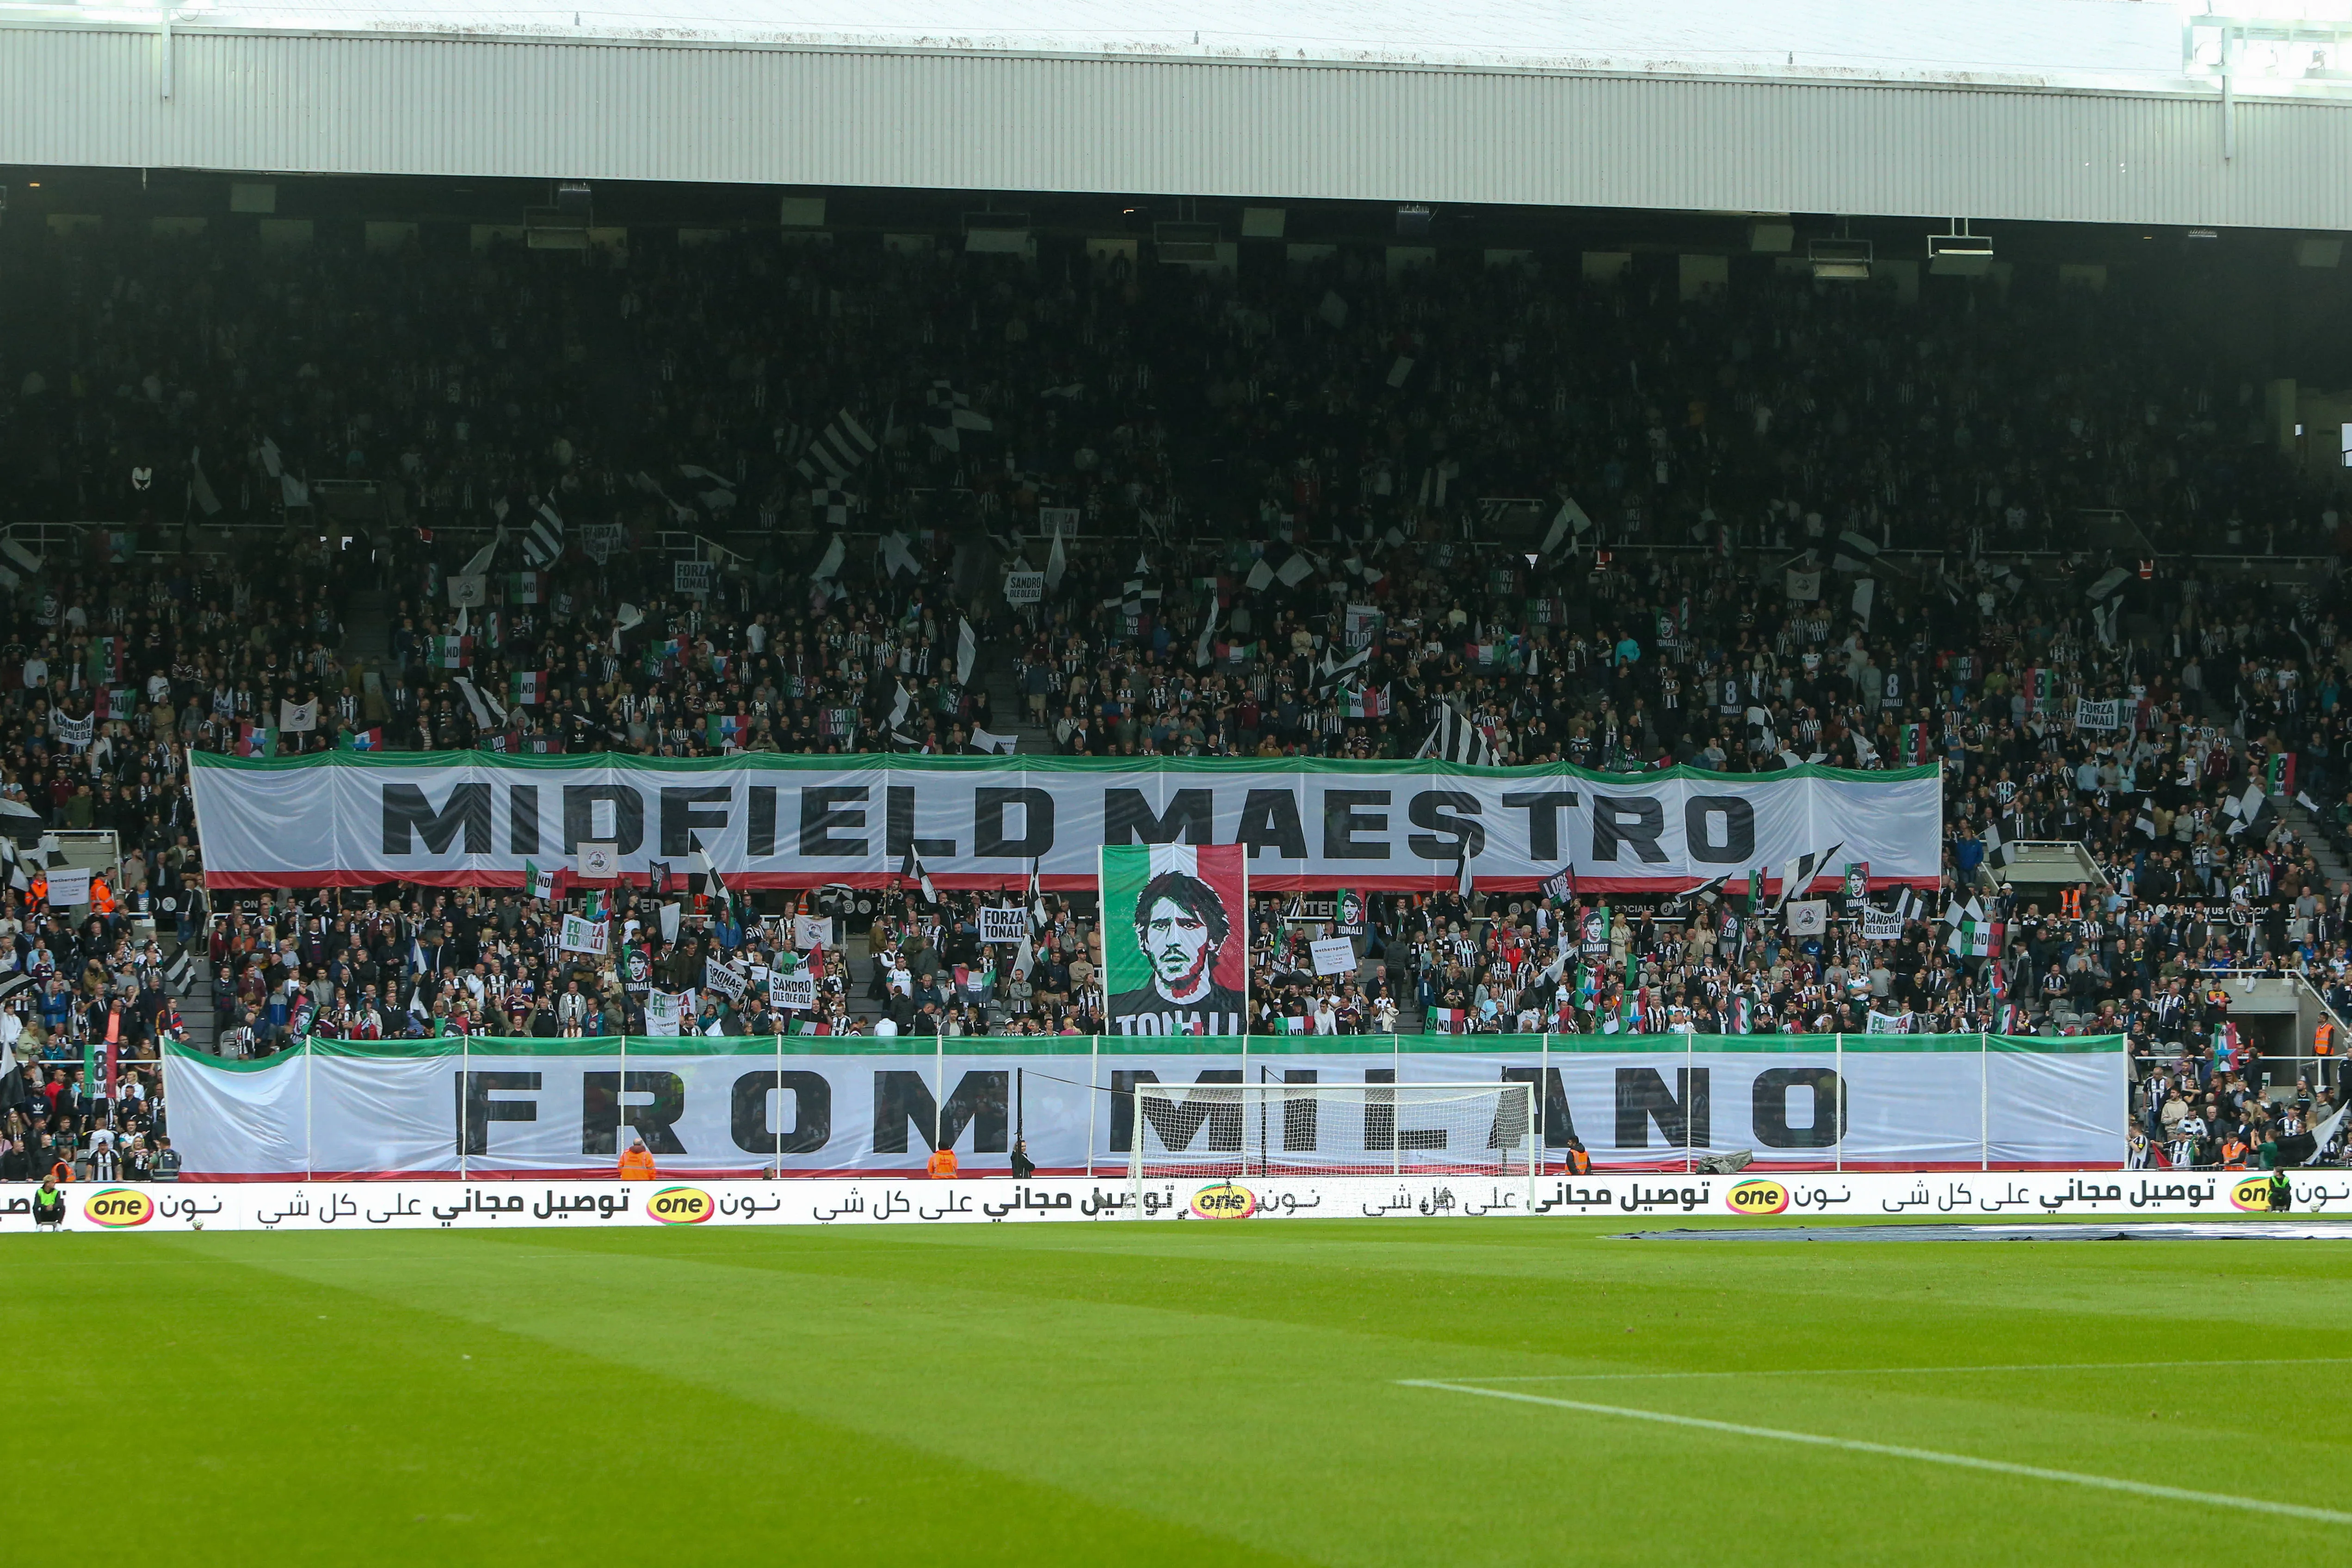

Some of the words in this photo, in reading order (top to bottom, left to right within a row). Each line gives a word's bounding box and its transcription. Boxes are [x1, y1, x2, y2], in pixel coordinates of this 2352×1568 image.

[677, 578, 709, 589] TONAL
[1010, 577, 1041, 589] SANDRO
[1020, 590, 1031, 598] OLE
[1031, 589, 1041, 598] OLE
[1725, 680, 1737, 704] 8
[1887, 673, 1898, 698] 8
[1882, 698, 1902, 707] TONALI
[2080, 704, 2114, 715] FORZA
[1721, 706, 1741, 715] TONALI
[2079, 714, 2114, 726] TONALI
[2275, 758, 2288, 782] 8
[382, 783, 1054, 857] MIDFIELD
[1105, 788, 1757, 863] MAESTRO
[1845, 898, 1870, 906] TONALI
[984, 910, 1024, 925] FORZA
[1865, 912, 1901, 924] SANDRO
[2210, 906, 2224, 915] US
[568, 919, 604, 938] FORZA
[983, 925, 1024, 939] TONALI
[1338, 926, 1363, 935] TONALI
[1865, 925, 1877, 934] OLE
[1877, 926, 1888, 934] OLE
[1889, 925, 1900, 934] OLE
[566, 933, 604, 950] TONALI
[1962, 931, 2001, 946] SANDRO
[1314, 945, 1349, 953] wetherspoon
[625, 983, 651, 992] TONALI
[772, 977, 812, 994] SANDRO
[653, 994, 691, 1006] FORZA
[772, 992, 785, 1003] OLE
[785, 994, 798, 1005] OLE
[798, 994, 811, 1005] OLE
[1426, 1018, 1465, 1033] SANDRO
[94, 1050, 108, 1082] 8
[455, 1070, 1009, 1155] FROM
[1110, 1067, 1847, 1152] MILANO
[1621, 1182, 1710, 1212] توصيل
[1735, 1190, 1778, 1205] one
[1938, 1183, 1972, 1211] كل
[1976, 1183, 2030, 1212] على
[2040, 1178, 2122, 1214] مجاني
[2130, 1178, 2215, 1208] توصيل
[2239, 1188, 2268, 1203] on
[94, 1199, 142, 1216] one
[320, 1193, 357, 1224] كل
[367, 1193, 422, 1223] على
[433, 1189, 524, 1227] مجاني
[534, 1189, 630, 1220] توصيل
[656, 1198, 704, 1213] one
[874, 1191, 910, 1221] كل
[920, 1191, 973, 1220] على
[984, 1186, 1072, 1223] مجاني
[1200, 1194, 1245, 1210] one
